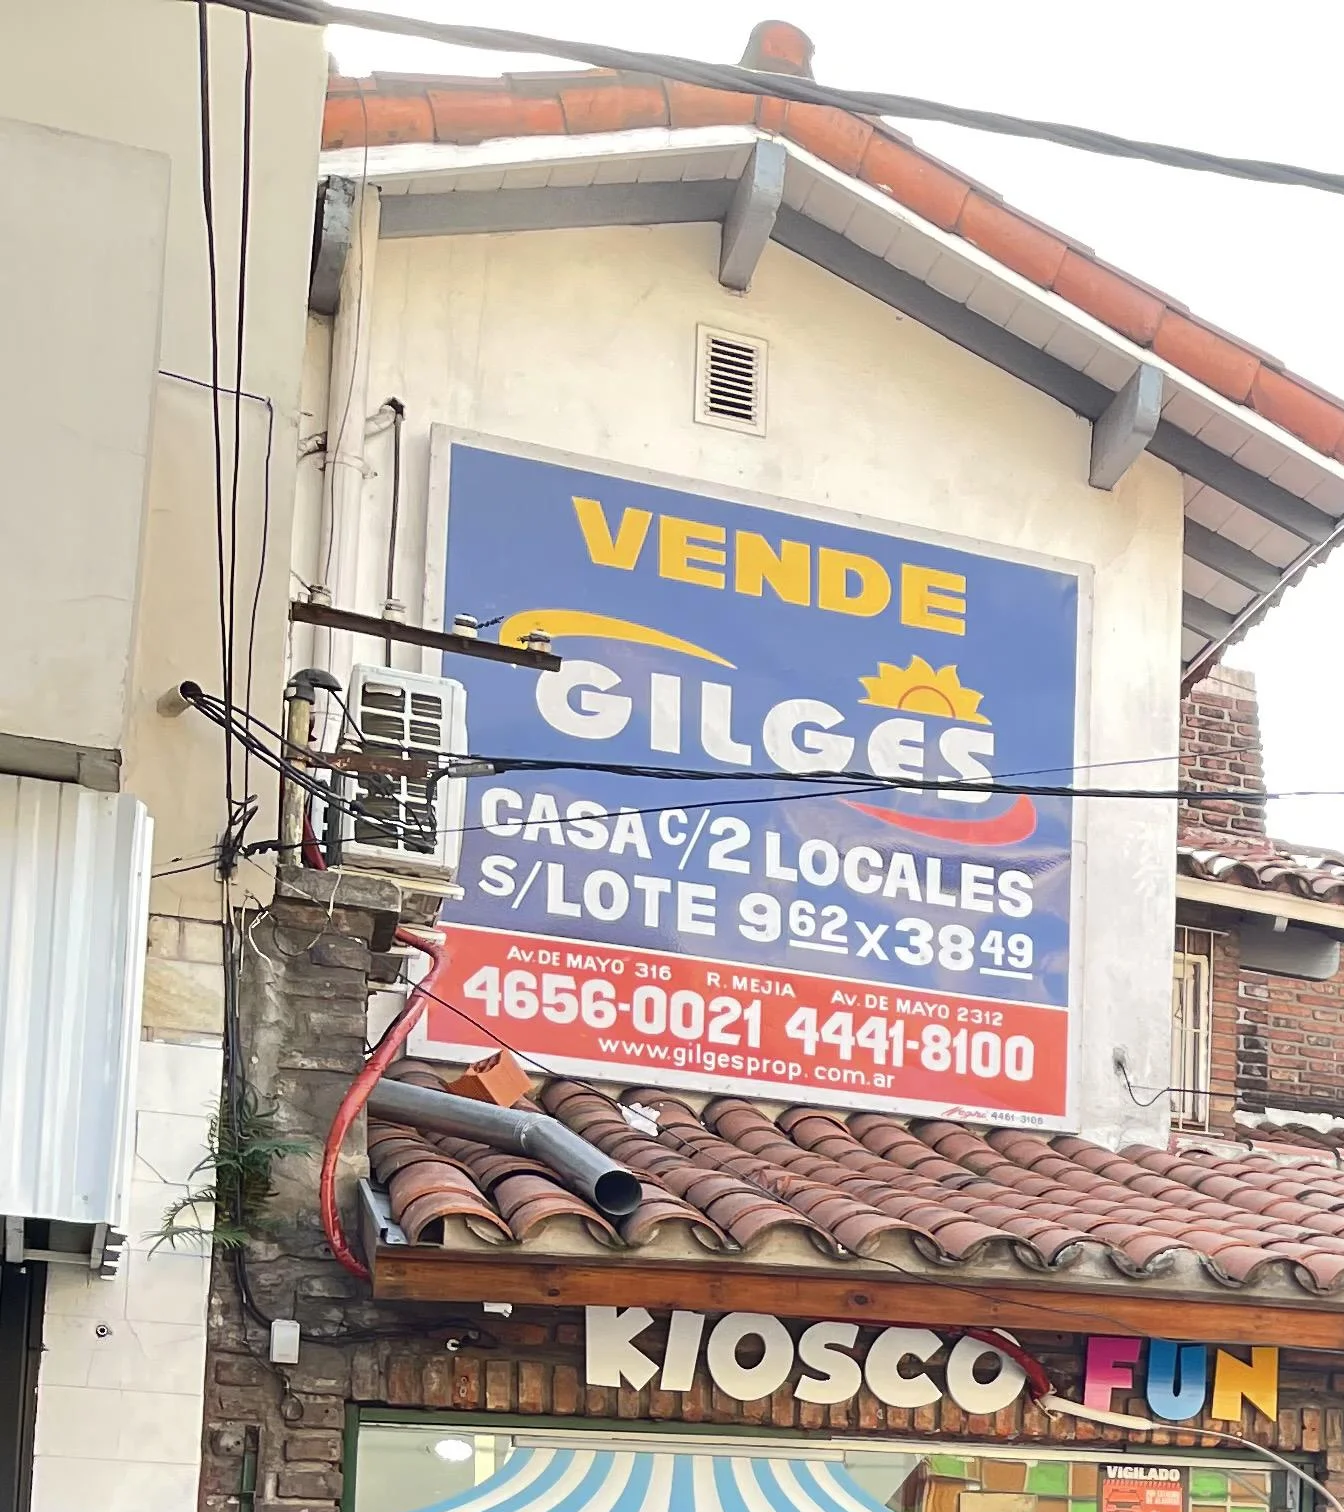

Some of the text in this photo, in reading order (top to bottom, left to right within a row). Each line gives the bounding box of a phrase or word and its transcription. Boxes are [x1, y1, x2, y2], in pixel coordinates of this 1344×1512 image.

[571, 496, 967, 637] VENDE
[536, 659, 995, 803] GILGES
[478, 855, 718, 938] S/LOTE
[480, 788, 652, 860] CASA
[766, 831, 1035, 919] LOCALES
[462, 964, 1036, 1083] 4656-0021 4441-8100
[565, 953, 626, 977] MAYO
[634, 962, 673, 982] 316
[735, 975, 797, 999] MEJIA
[896, 997, 951, 1022] MAYO
[956, 1006, 1004, 1028] 2312
[585, 1304, 1279, 1422] KIOSCO FUN
[1106, 1465, 1181, 1482] VIGILADO
